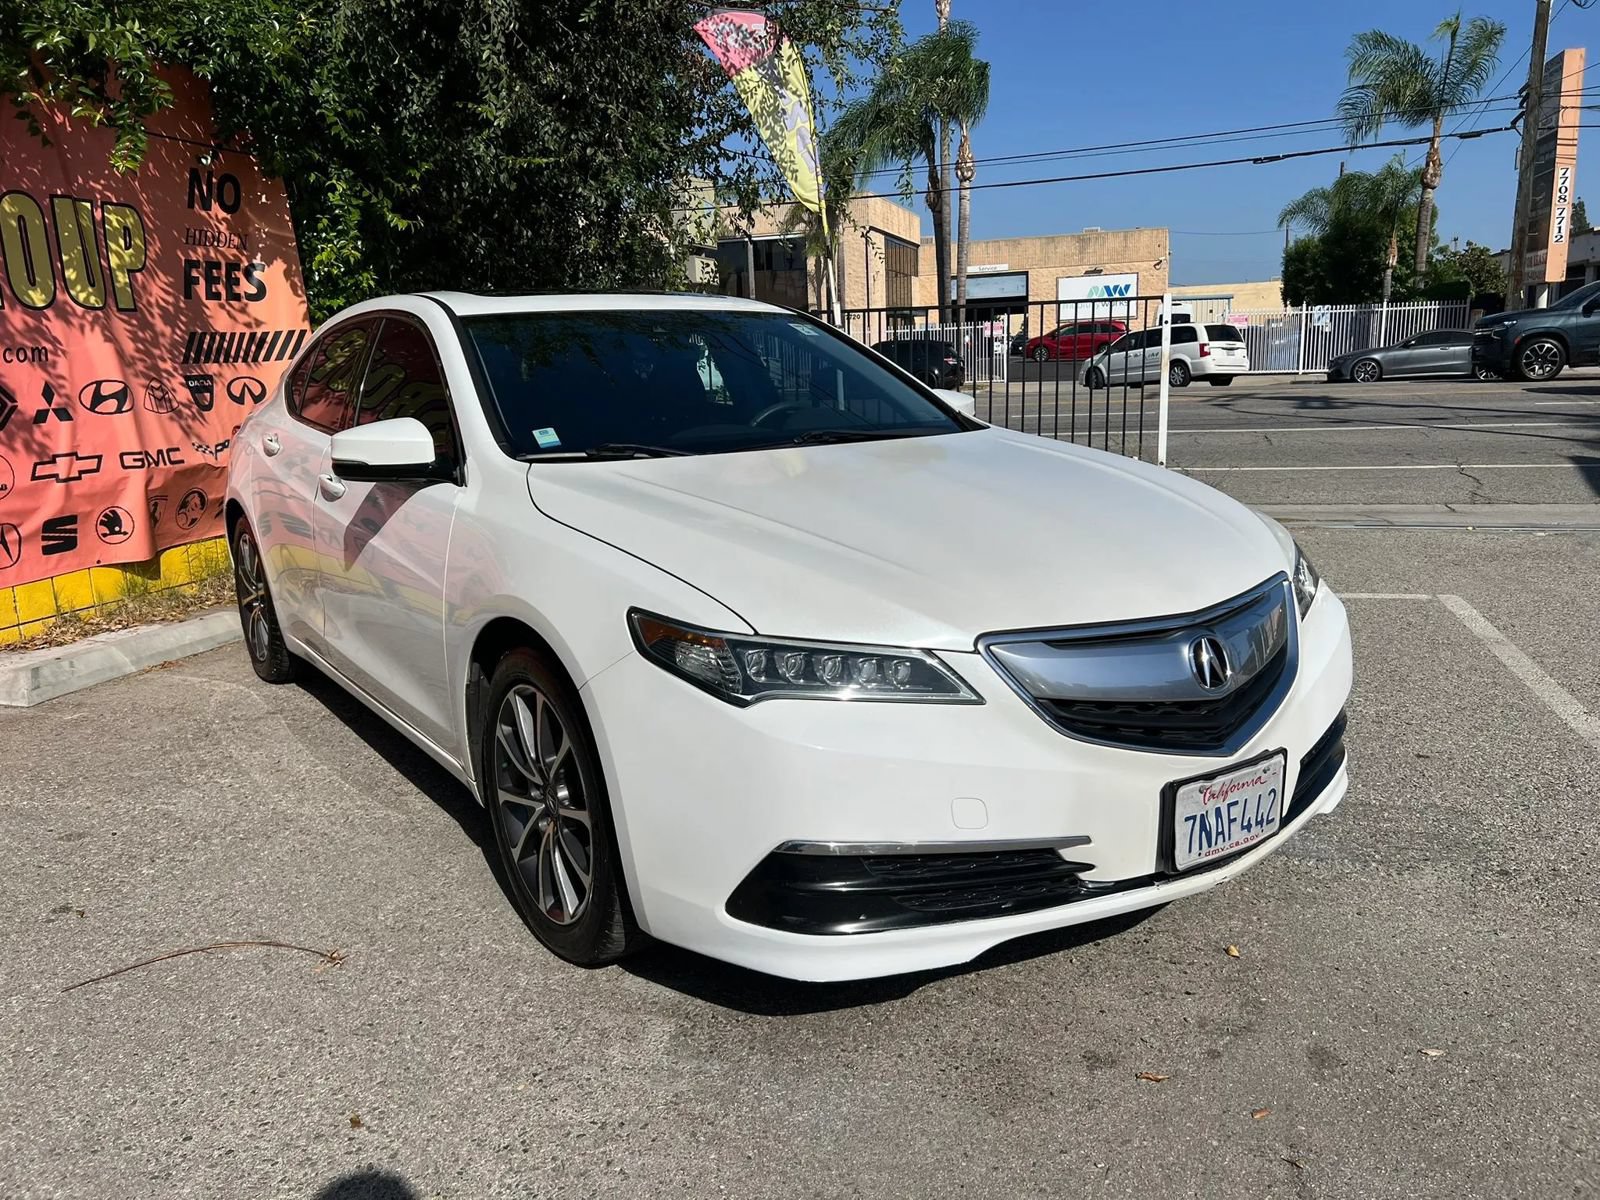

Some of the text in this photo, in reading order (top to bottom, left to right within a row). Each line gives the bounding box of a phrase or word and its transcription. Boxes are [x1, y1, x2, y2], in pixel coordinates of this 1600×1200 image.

[187, 167, 241, 215] NO
[1554, 167, 1569, 243] 7708 7712
[0, 189, 147, 313] OUP
[184, 227, 248, 251] HIDDEN
[183, 259, 267, 302] FEES
[119, 446, 185, 470] GMC
[1203, 774, 1267, 805] California
[1184, 787, 1278, 854] 7NAF442
[1204, 832, 1260, 858] dmv.ca.gov
